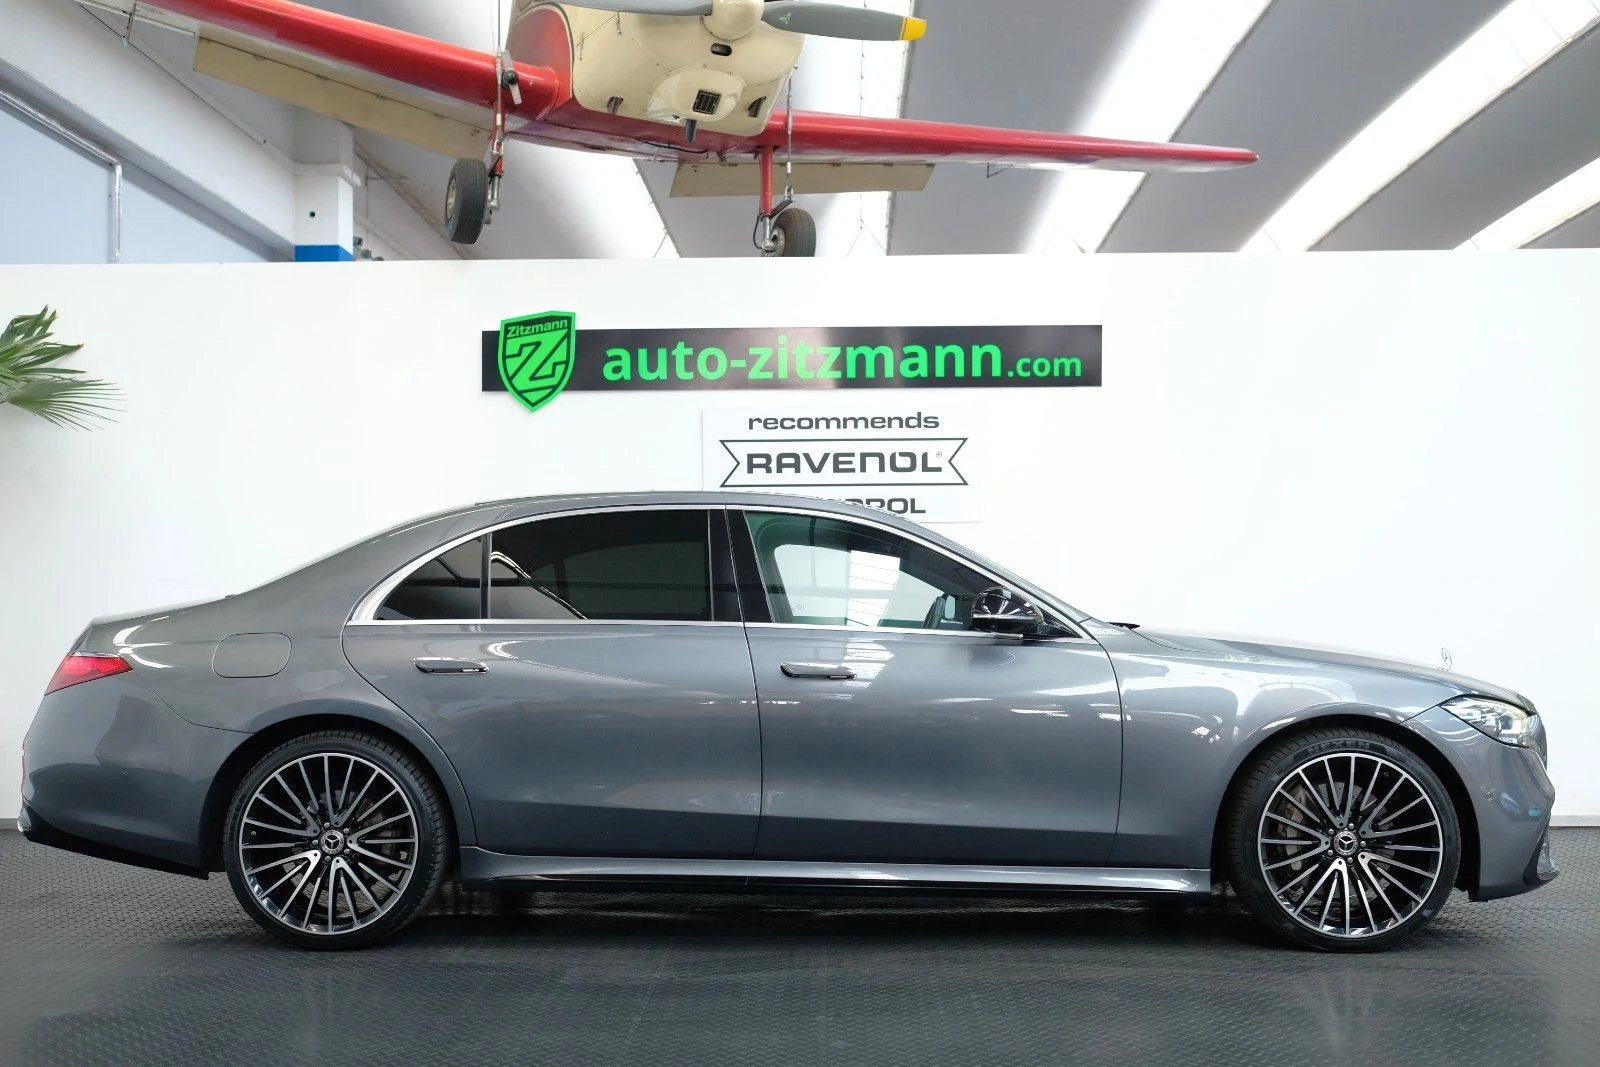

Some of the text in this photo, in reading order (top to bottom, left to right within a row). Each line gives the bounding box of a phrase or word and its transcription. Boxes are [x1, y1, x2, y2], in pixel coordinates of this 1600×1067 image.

[507, 320, 568, 338] Zitzmann
[602, 335, 1082, 381] auto-zitzmann.com
[748, 411, 940, 430] recommends
